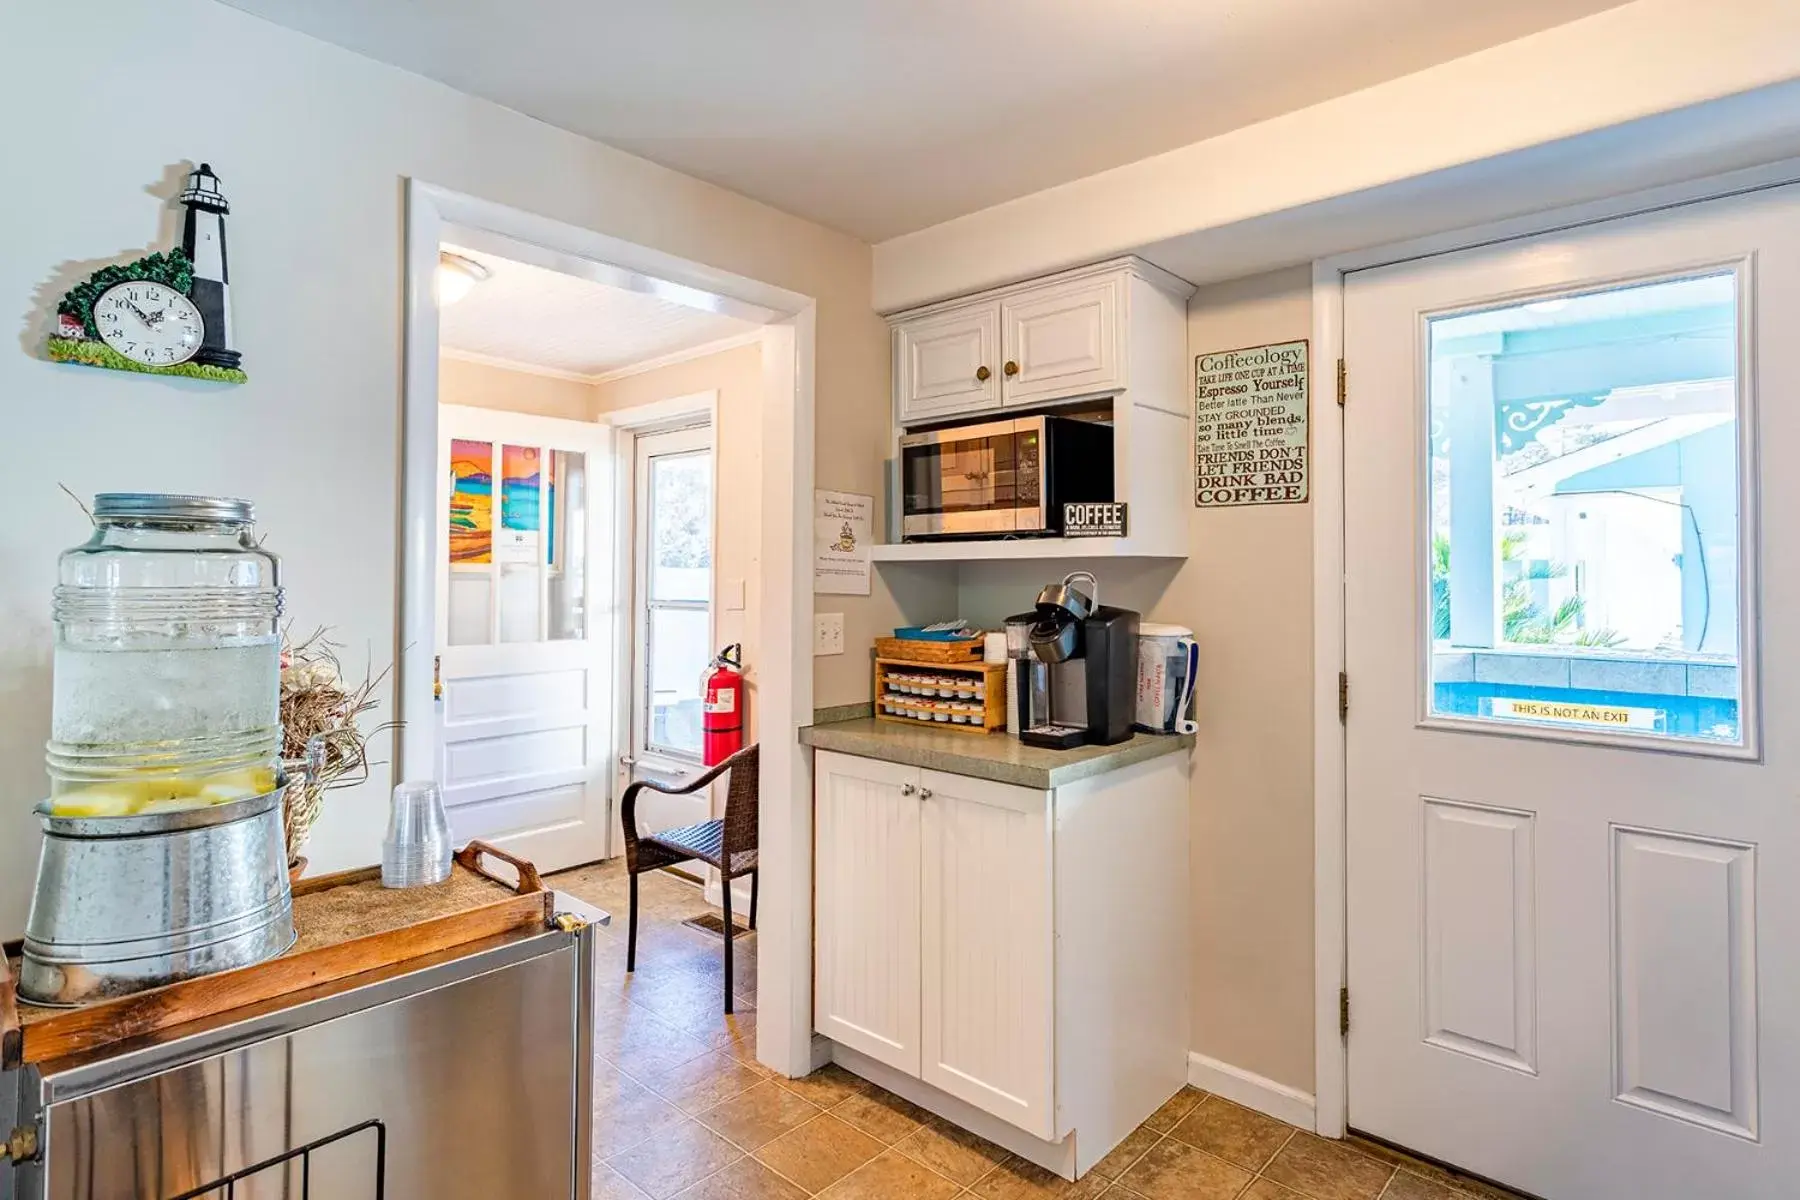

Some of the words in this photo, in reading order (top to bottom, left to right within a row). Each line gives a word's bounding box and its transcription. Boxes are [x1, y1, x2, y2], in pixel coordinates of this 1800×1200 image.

[130, 291, 138, 301] 11
[146, 290, 160, 301] 12
[107, 313, 118, 321] 9
[178, 310, 188, 320] 2
[112, 329, 123, 338] 8
[127, 341, 137, 351] 7
[144, 349, 154, 357] 6
[1219, 374, 1232, 382] LIFE
[1235, 371, 1250, 380] ONE
[1267, 367, 1278, 376] AT
[1279, 366, 1285, 375] A
[1198, 384, 1248, 400] Espresso
[1252, 375, 1305, 391] Yourself
[1199, 399, 1225, 410] Better
[1250, 394, 1274, 404] Than
[1276, 392, 1304, 402] Never
[1198, 413, 1222, 423] STAY
[1225, 406, 1286, 420] GROUNDED
[1199, 424, 1212, 432] so
[1217, 420, 1253, 430] many
[1258, 414, 1305, 426] blends,
[1198, 434, 1211, 442] so
[1216, 430, 1248, 440] little
[1253, 428, 1284, 437] time
[1198, 450, 1255, 464] FRIENDS
[1260, 446, 1306, 460] DON'T
[1198, 464, 1227, 476] LET
[1232, 458, 1304, 474] FRIENDS
[1198, 474, 1257, 489] DRINK
[1264, 472, 1304, 485] BAD
[1198, 486, 1302, 504] COFFEE
[1066, 504, 1122, 524] COFFEE
[1512, 703, 1537, 714] THIS
[1540, 706, 1550, 716] IS
[1554, 708, 1577, 718] NOT
[1582, 710, 1600, 720] AN
[1604, 711, 1630, 722] EXIT
